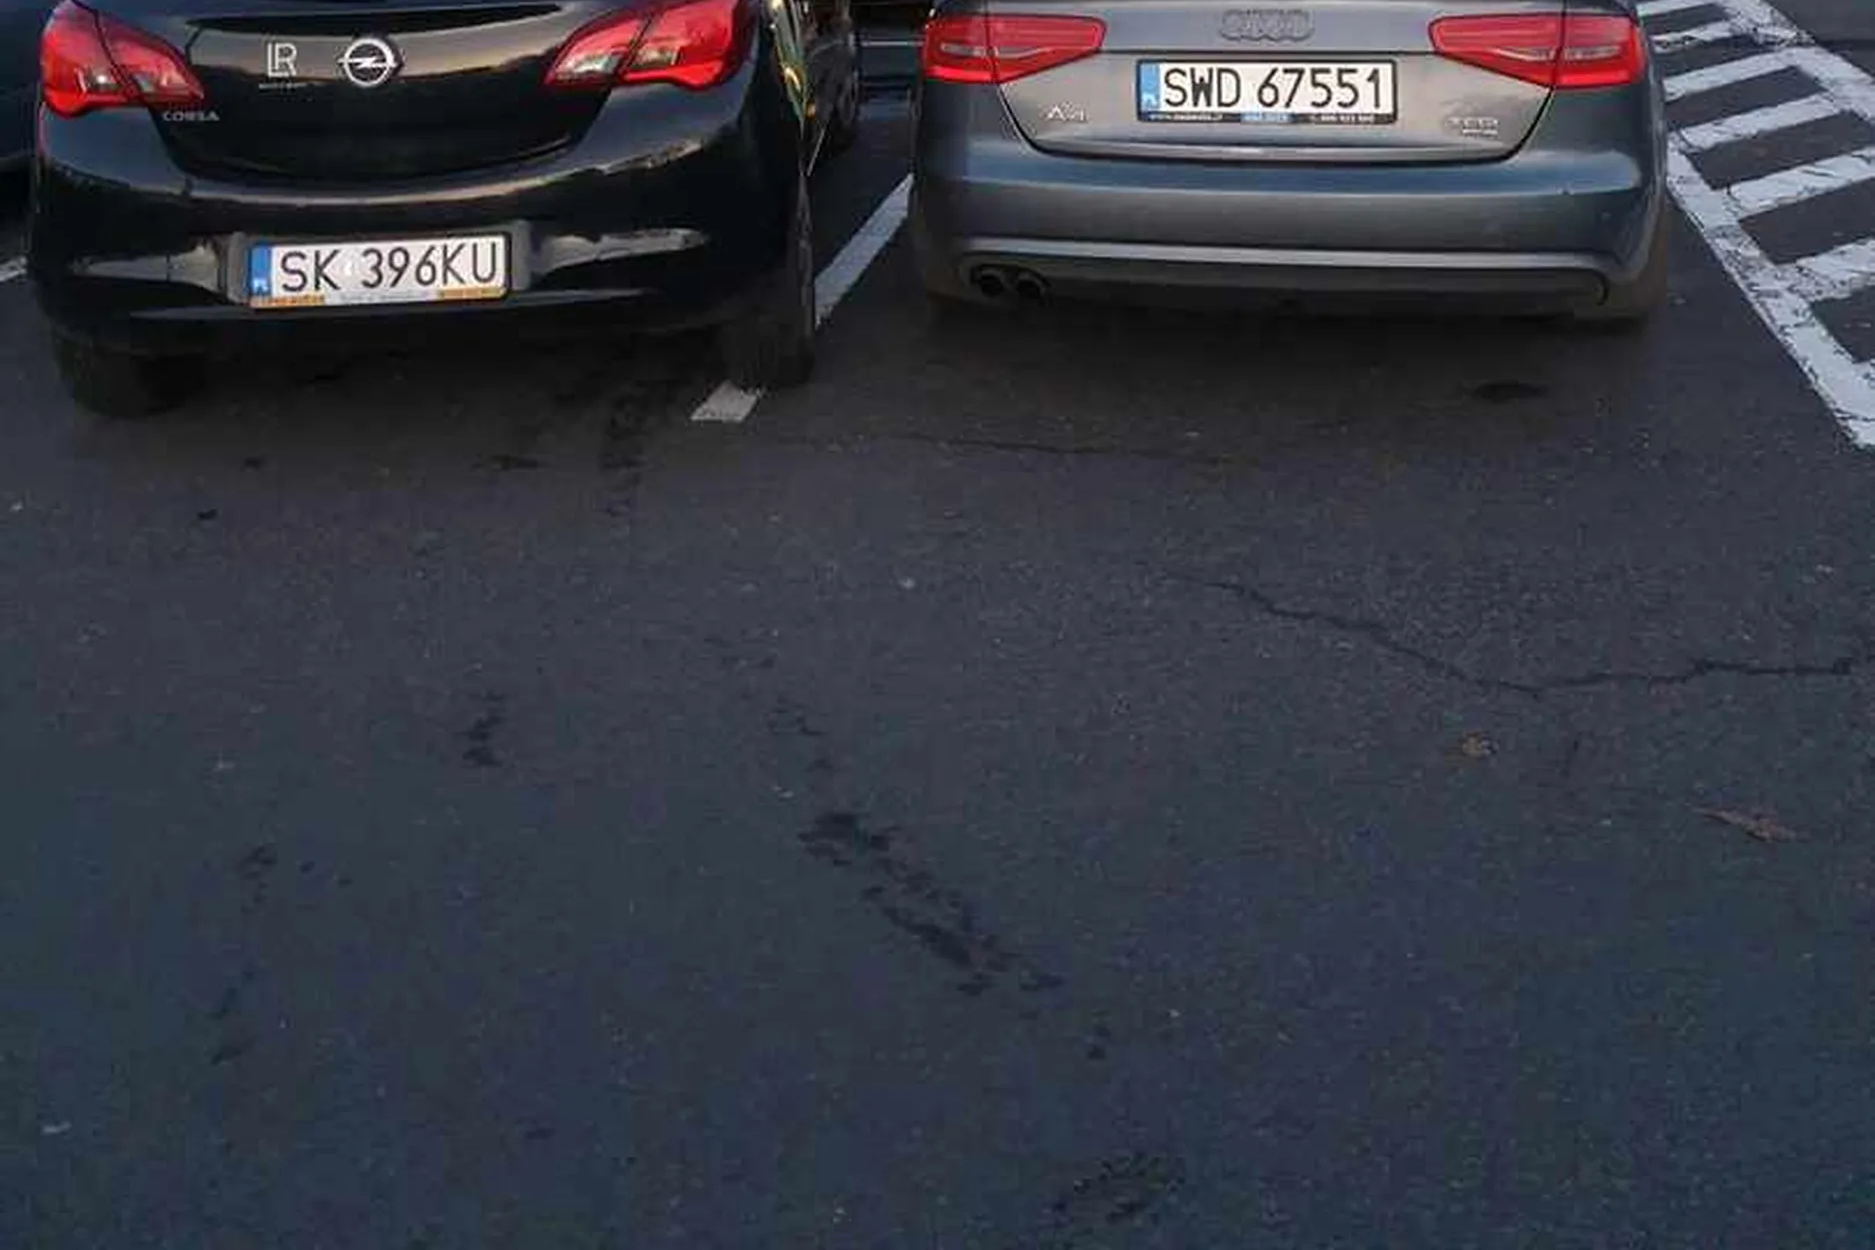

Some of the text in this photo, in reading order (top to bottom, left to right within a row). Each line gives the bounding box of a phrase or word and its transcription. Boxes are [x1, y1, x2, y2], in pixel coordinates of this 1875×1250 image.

[1164, 67, 1241, 108] SWD
[1257, 67, 1381, 109] 67551
[281, 242, 497, 292] SK 396KU
